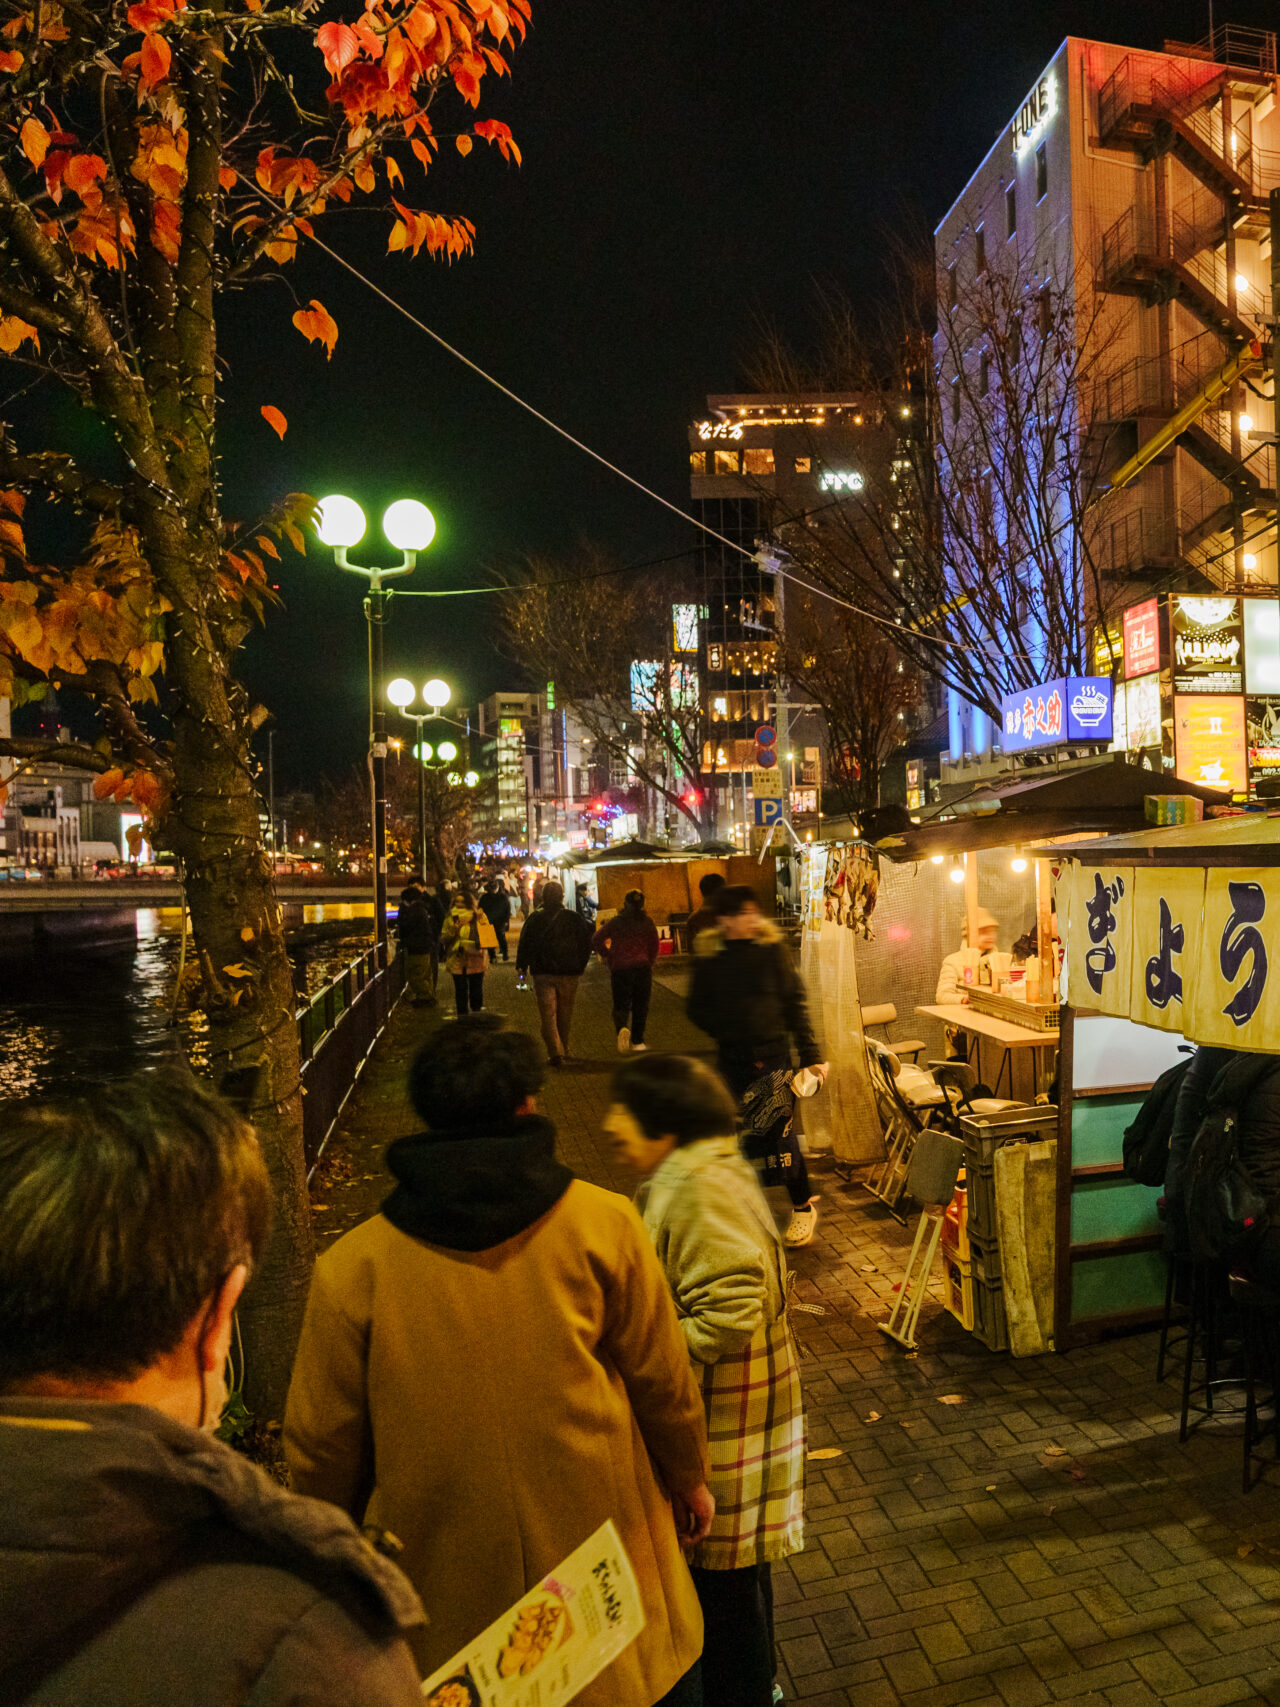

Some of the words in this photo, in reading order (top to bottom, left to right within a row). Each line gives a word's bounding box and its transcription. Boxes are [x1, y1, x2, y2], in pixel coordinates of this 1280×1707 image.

[699, 422, 743, 440] なだ万
[1023, 689, 1062, 740] 赤之助
[762, 800, 778, 823] P
